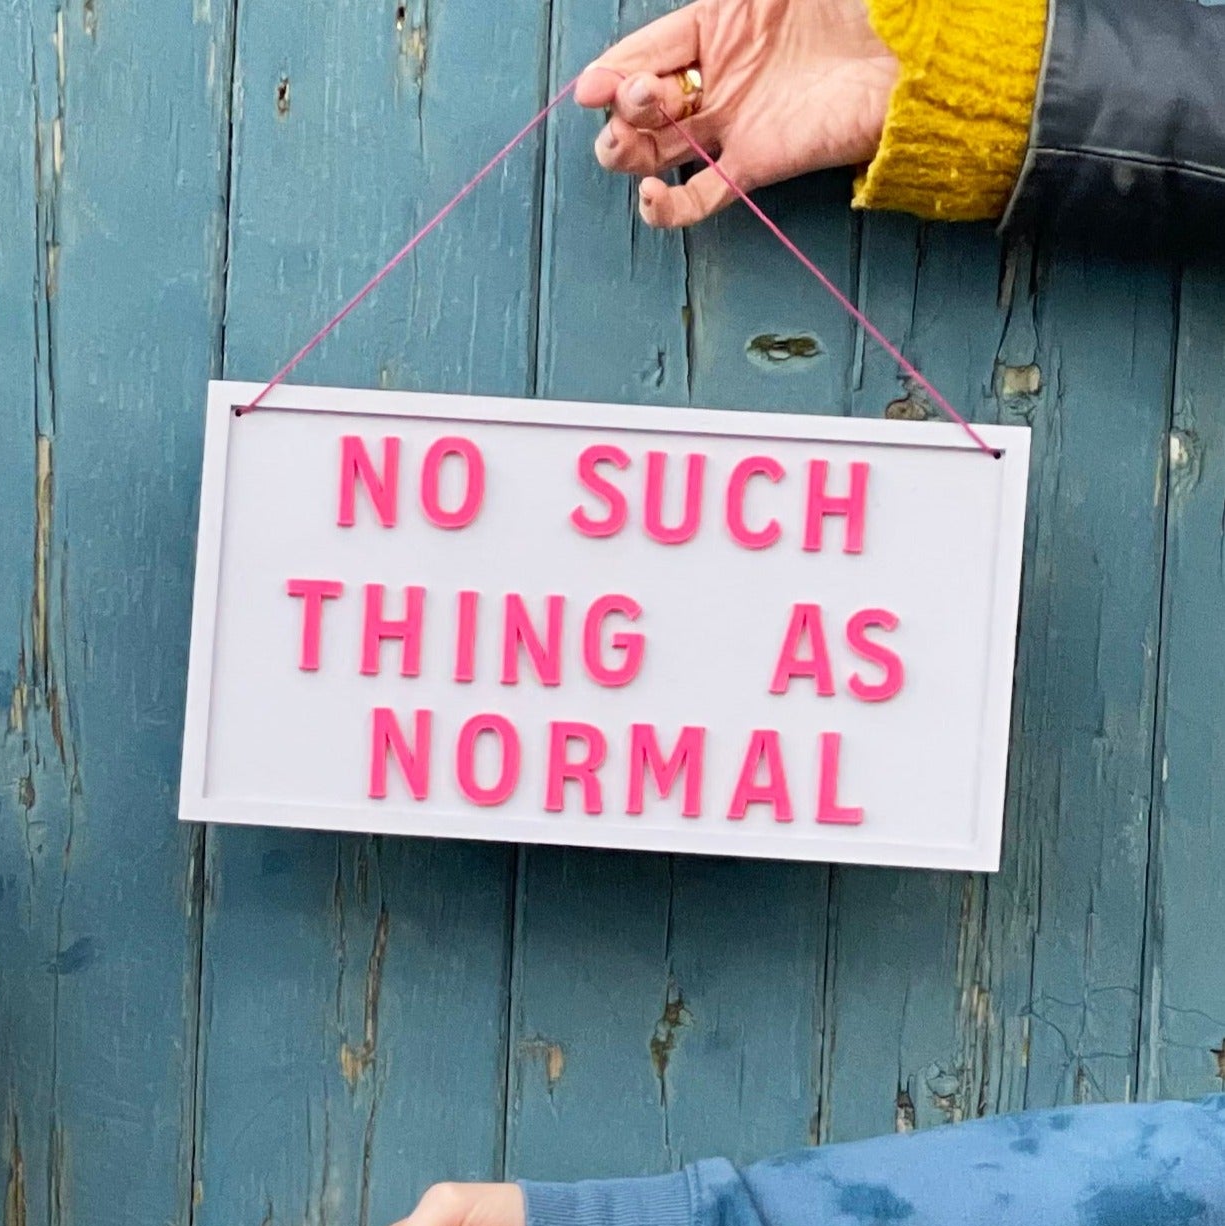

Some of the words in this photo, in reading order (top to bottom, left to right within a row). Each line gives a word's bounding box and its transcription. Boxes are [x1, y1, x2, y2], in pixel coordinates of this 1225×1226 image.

[336, 435, 487, 529] NO
[569, 444, 871, 555] SUCH
[286, 579, 646, 687] THING
[769, 603, 905, 702] AS
[368, 707, 864, 825] NORMAL
